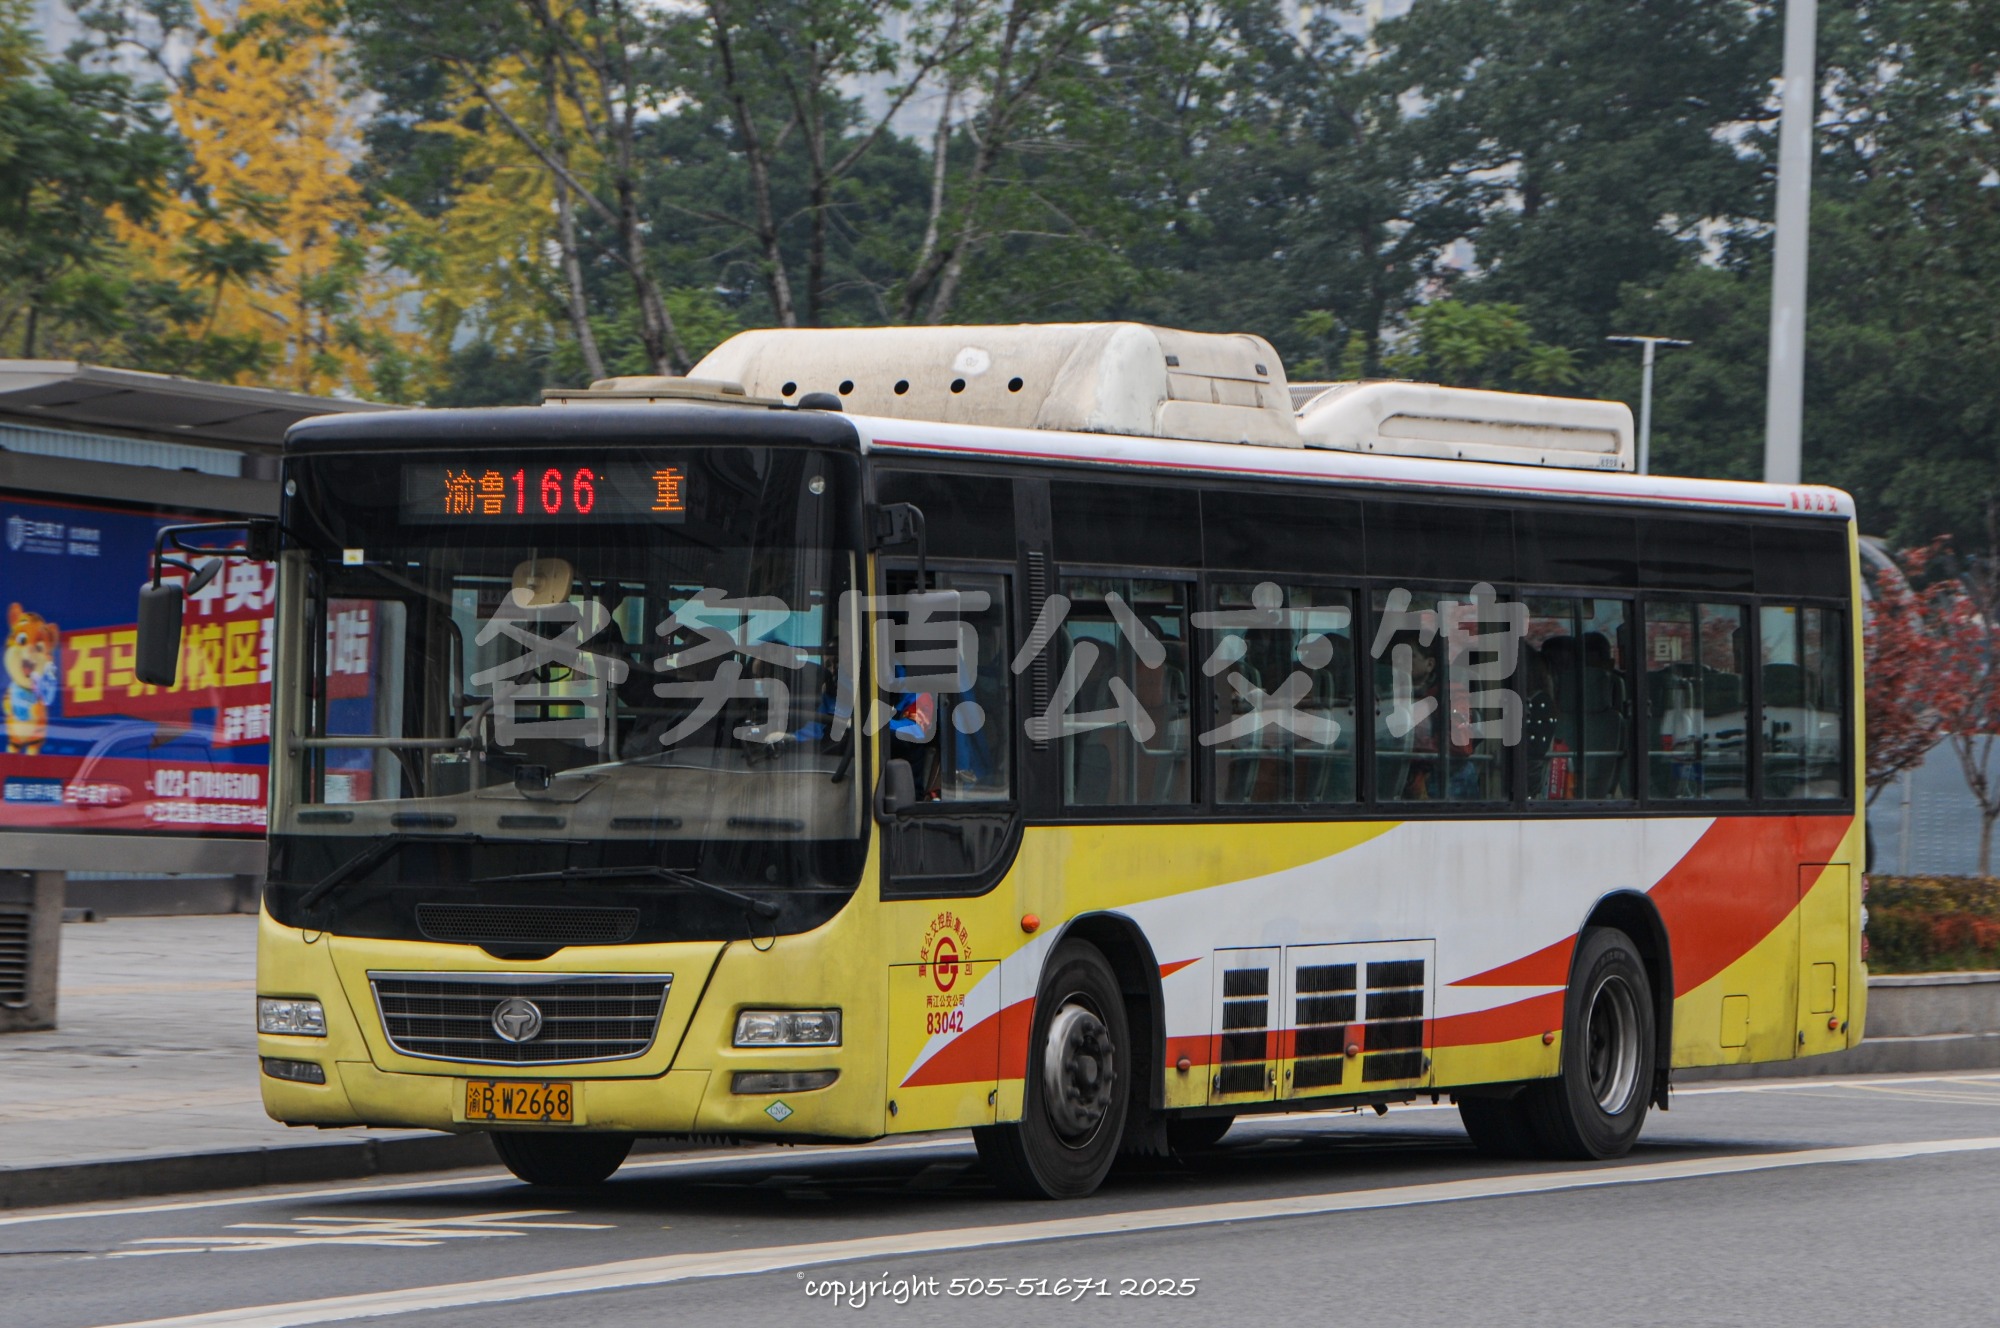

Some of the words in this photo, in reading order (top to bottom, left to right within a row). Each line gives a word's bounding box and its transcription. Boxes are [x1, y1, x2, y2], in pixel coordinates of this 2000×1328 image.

[651, 468, 686, 512] 重
[926, 994, 965, 1008] 两江公交公司
[926, 1011, 964, 1034] 83042
[769, 1106, 787, 1116] CNG
